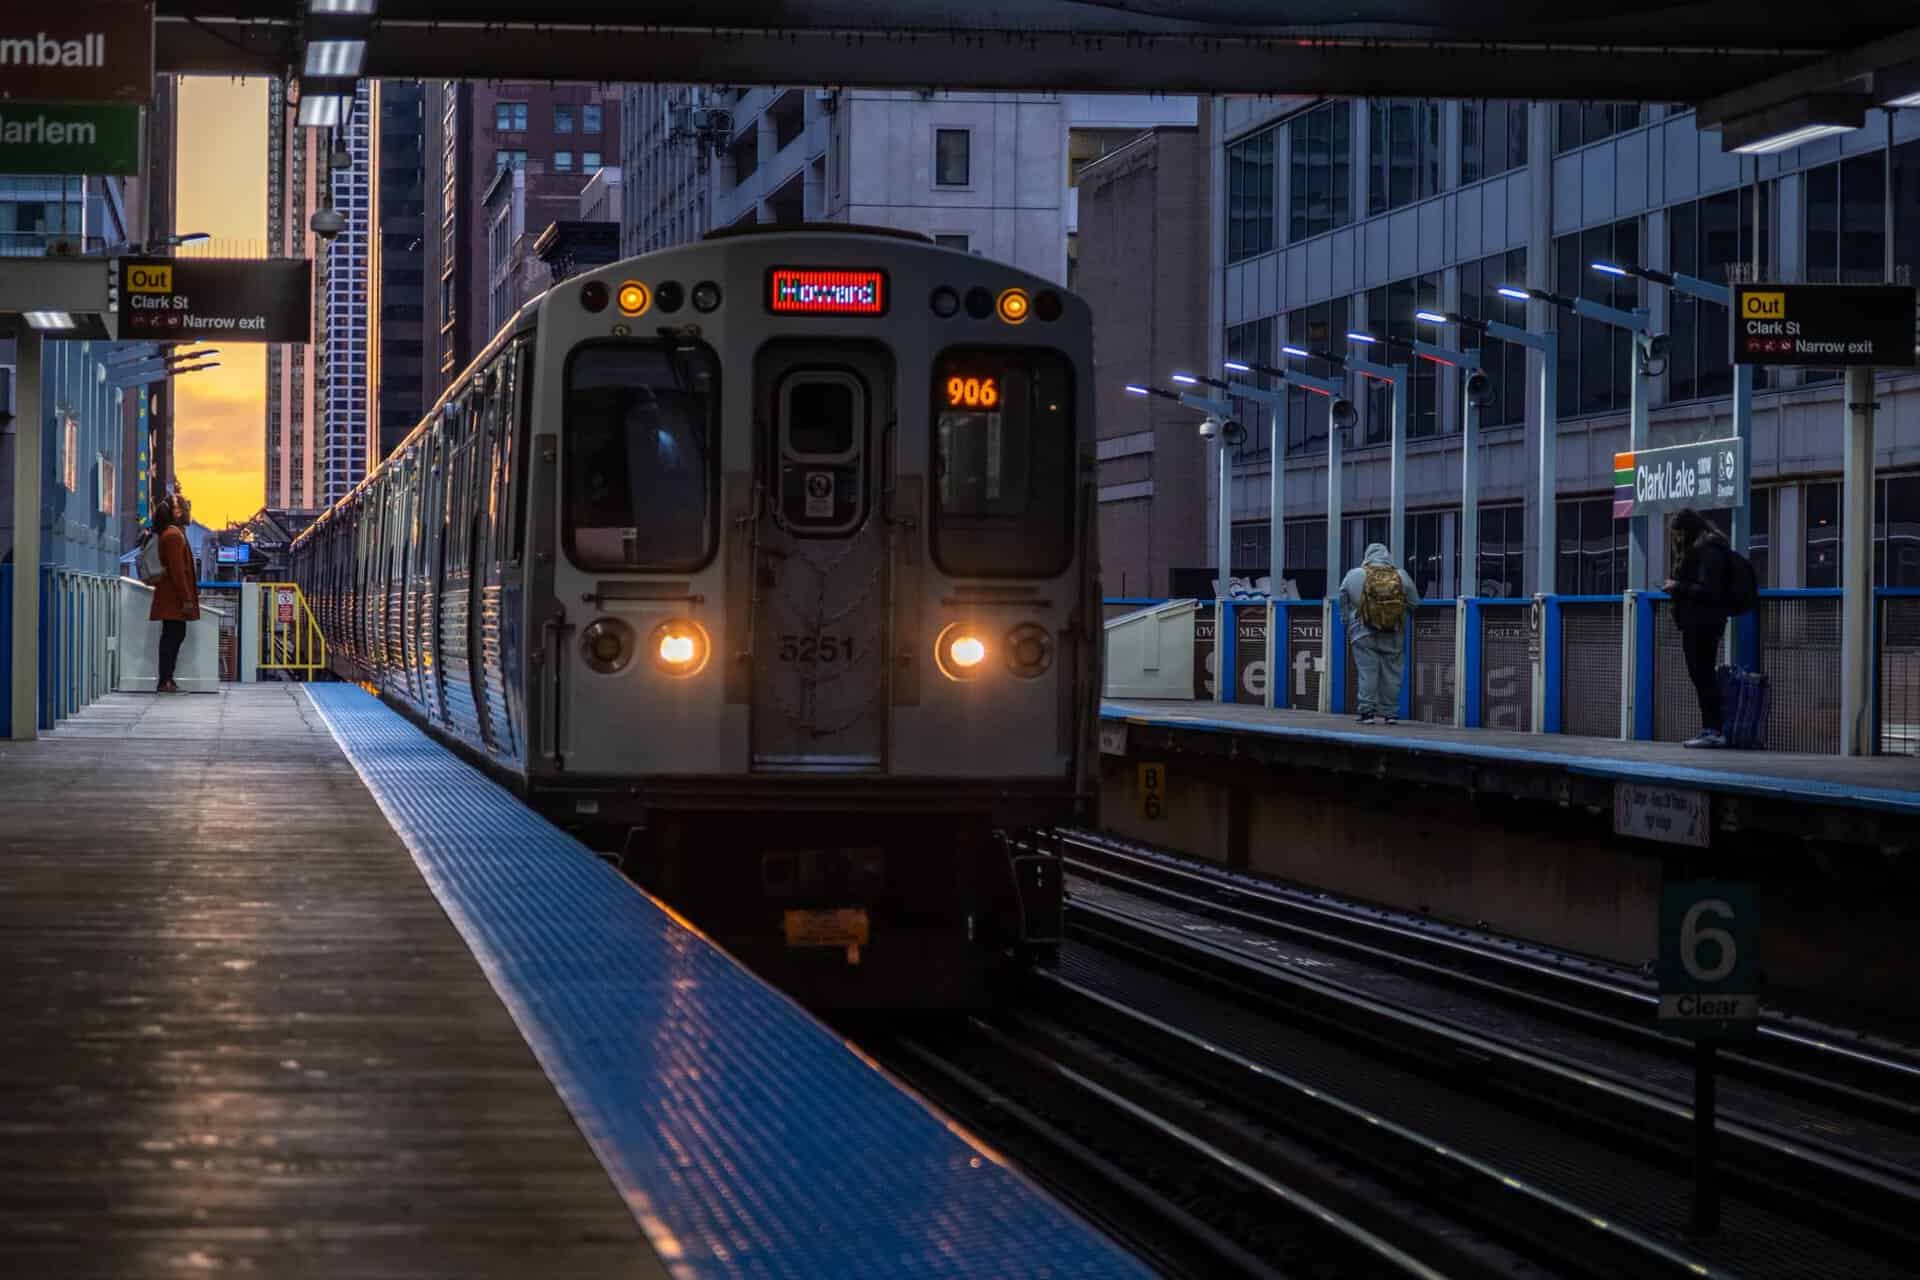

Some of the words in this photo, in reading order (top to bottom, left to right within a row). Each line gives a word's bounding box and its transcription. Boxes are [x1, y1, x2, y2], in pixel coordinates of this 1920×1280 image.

[132, 270, 167, 288] Out
[780, 279, 874, 303] Howard
[131, 295, 169, 309] Clark
[173, 295, 188, 309] St
[1747, 297, 1780, 314] Out
[182, 315, 235, 329] Narrow
[238, 316, 265, 330] exit
[1746, 320, 1783, 335] Clark
[1785, 321, 1801, 335] St
[1795, 339, 1845, 353] Narrow
[1847, 339, 1873, 353] exit
[948, 377, 998, 406] 906
[1636, 459, 1696, 502] Clark/Lake
[780, 636, 852, 662] 5251
[1679, 899, 1738, 983] 6
[1677, 995, 1740, 1016] Clear
